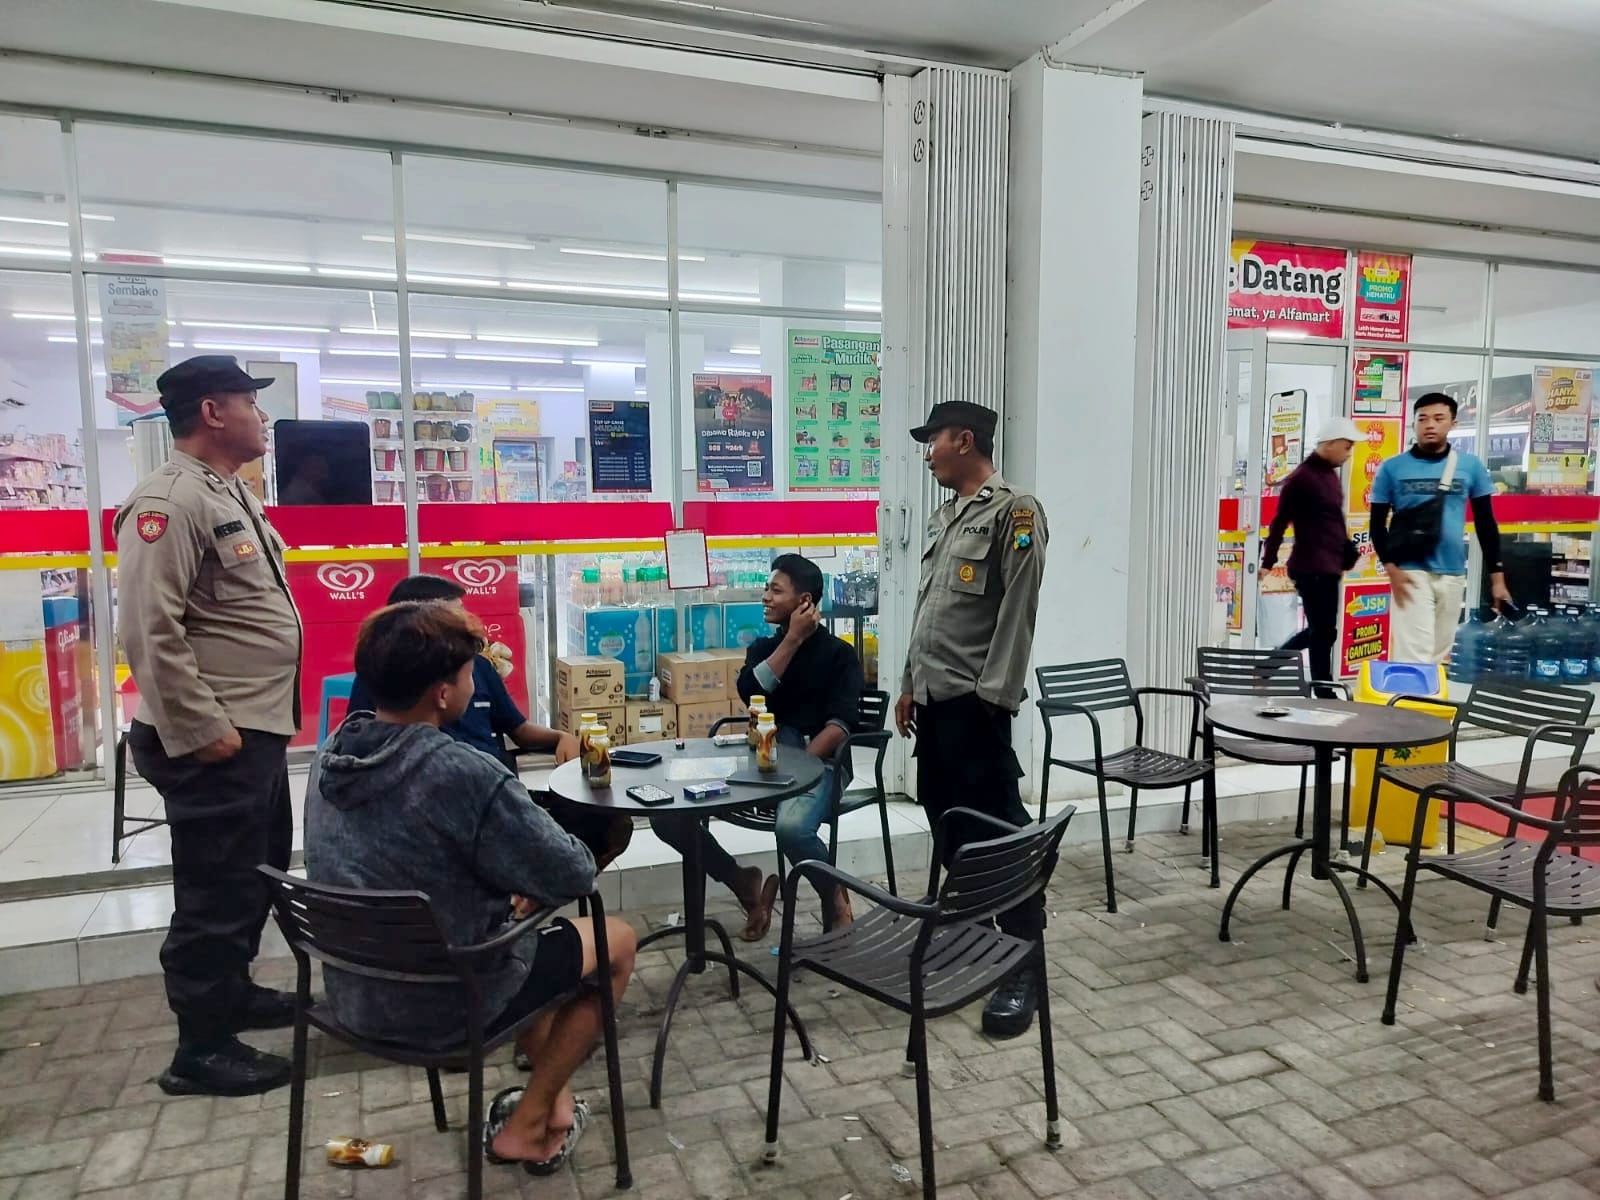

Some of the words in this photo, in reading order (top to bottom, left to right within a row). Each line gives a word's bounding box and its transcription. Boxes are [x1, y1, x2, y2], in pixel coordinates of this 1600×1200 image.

[1242, 258, 1342, 305] Datang
[1369, 284, 1394, 293] PROMO
[108, 282, 159, 297] Sembako
[1366, 291, 1396, 300] HEMATKU
[1262, 309, 1276, 322] ya
[1278, 307, 1331, 323] Alfamart
[822, 336, 880, 352] Pasangan
[835, 351, 872, 365] Mudik
[962, 526, 990, 536] POLRI
[329, 591, 365, 600] WALL'S
[464, 586, 497, 595] WALL'S
[1365, 596, 1387, 611] JSM
[1355, 624, 1378, 639] PROMO
[1349, 640, 1382, 660] GANTUNG
